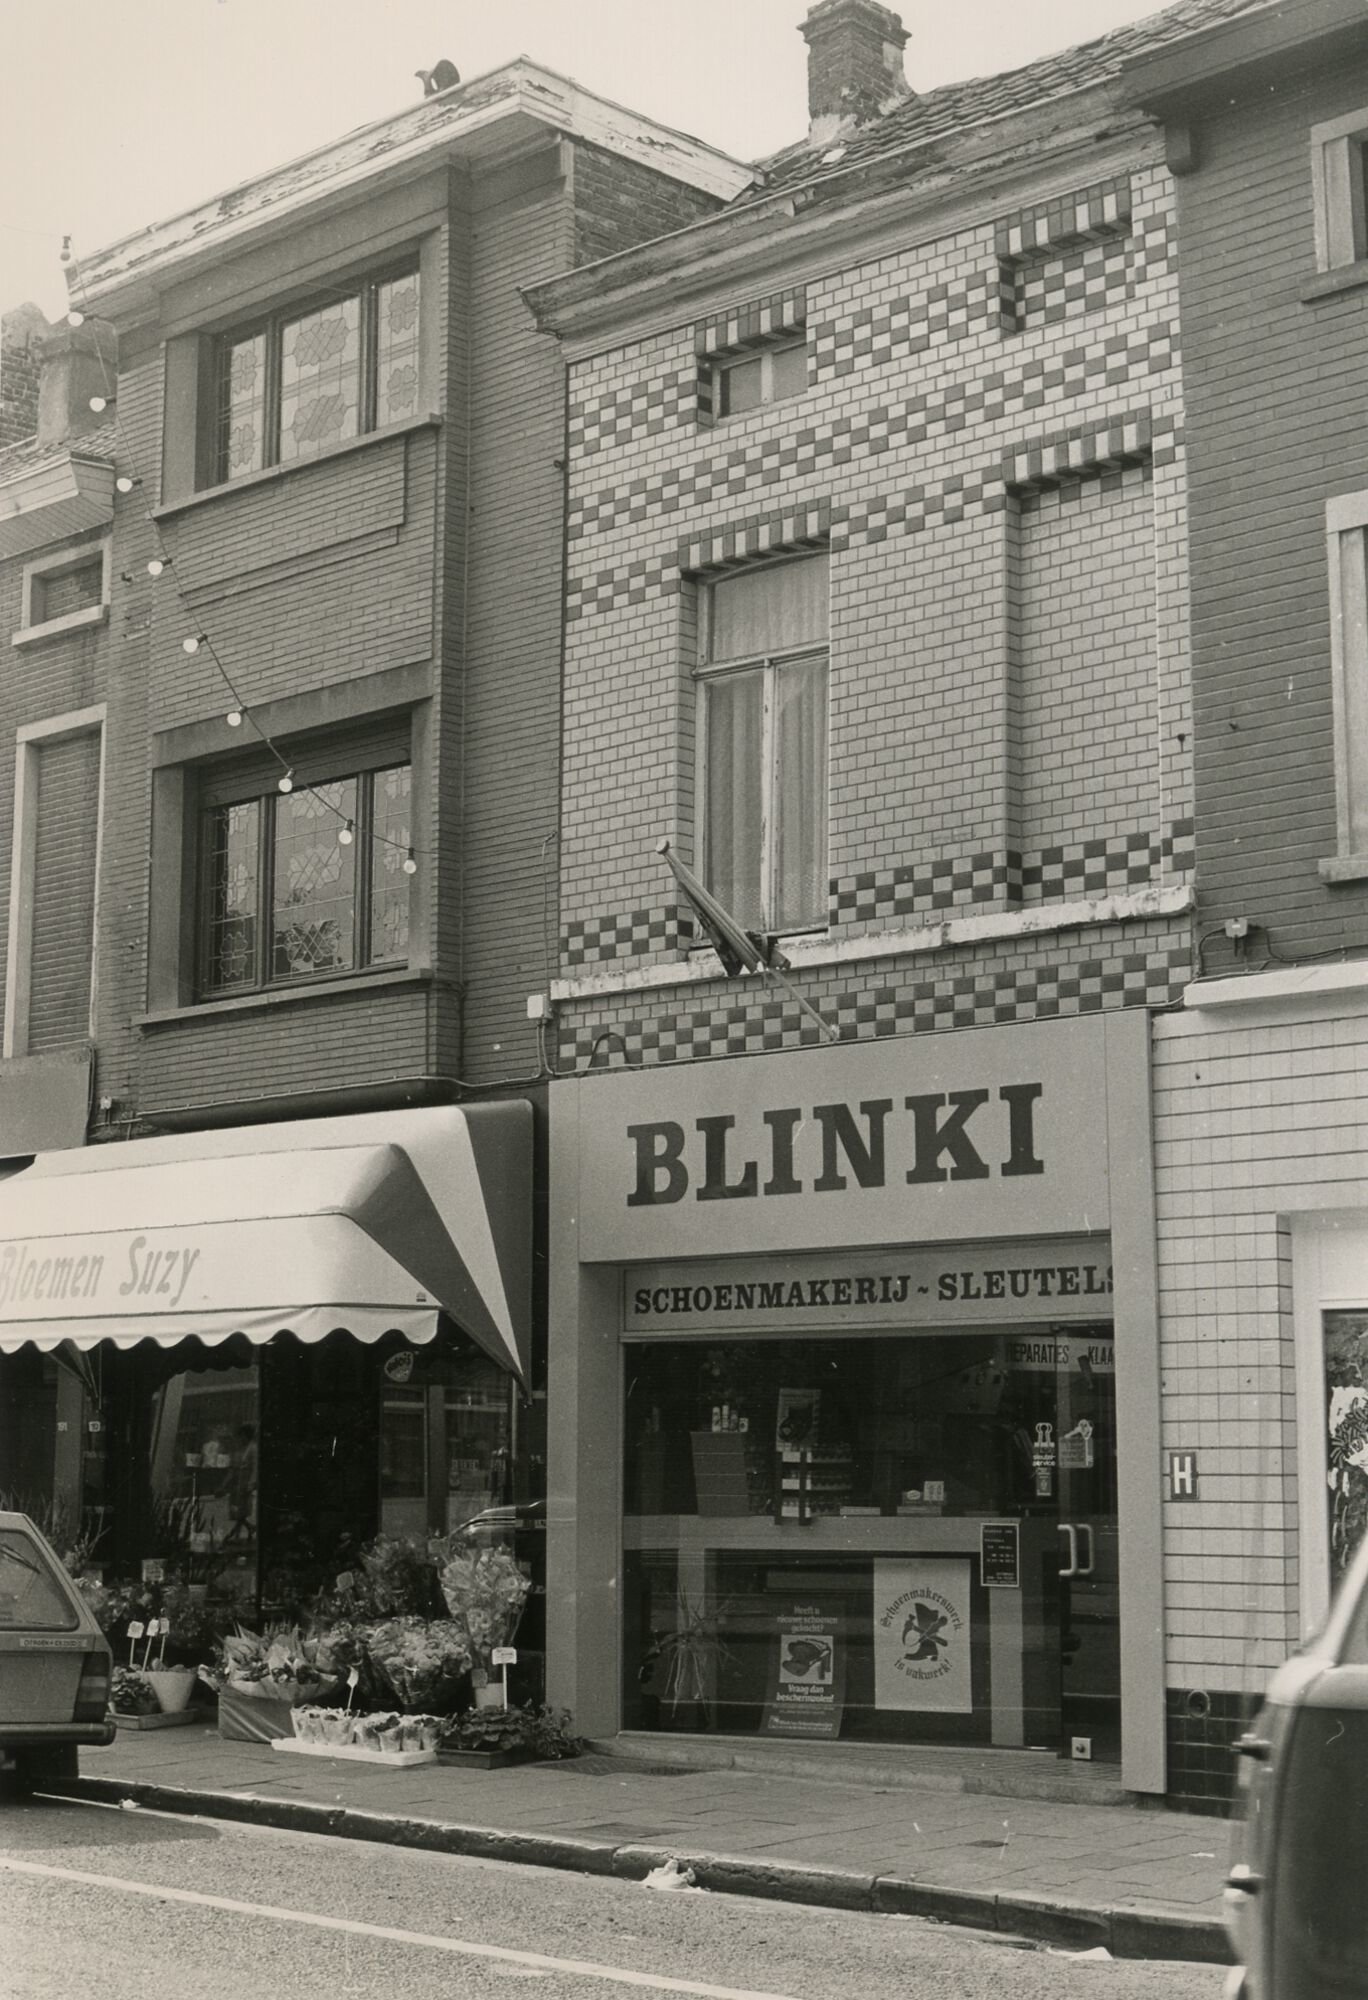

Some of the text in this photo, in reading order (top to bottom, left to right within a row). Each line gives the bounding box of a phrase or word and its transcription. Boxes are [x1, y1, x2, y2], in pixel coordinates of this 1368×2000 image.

[627, 1082, 1044, 1206] BLINKI
[119, 1236, 200, 1307] Suzy
[634, 1275, 911, 1314] SCHOENMAKERIJ
[1173, 1456, 1192, 1494] H
[788, 1684, 825, 1696] Vraag dan
